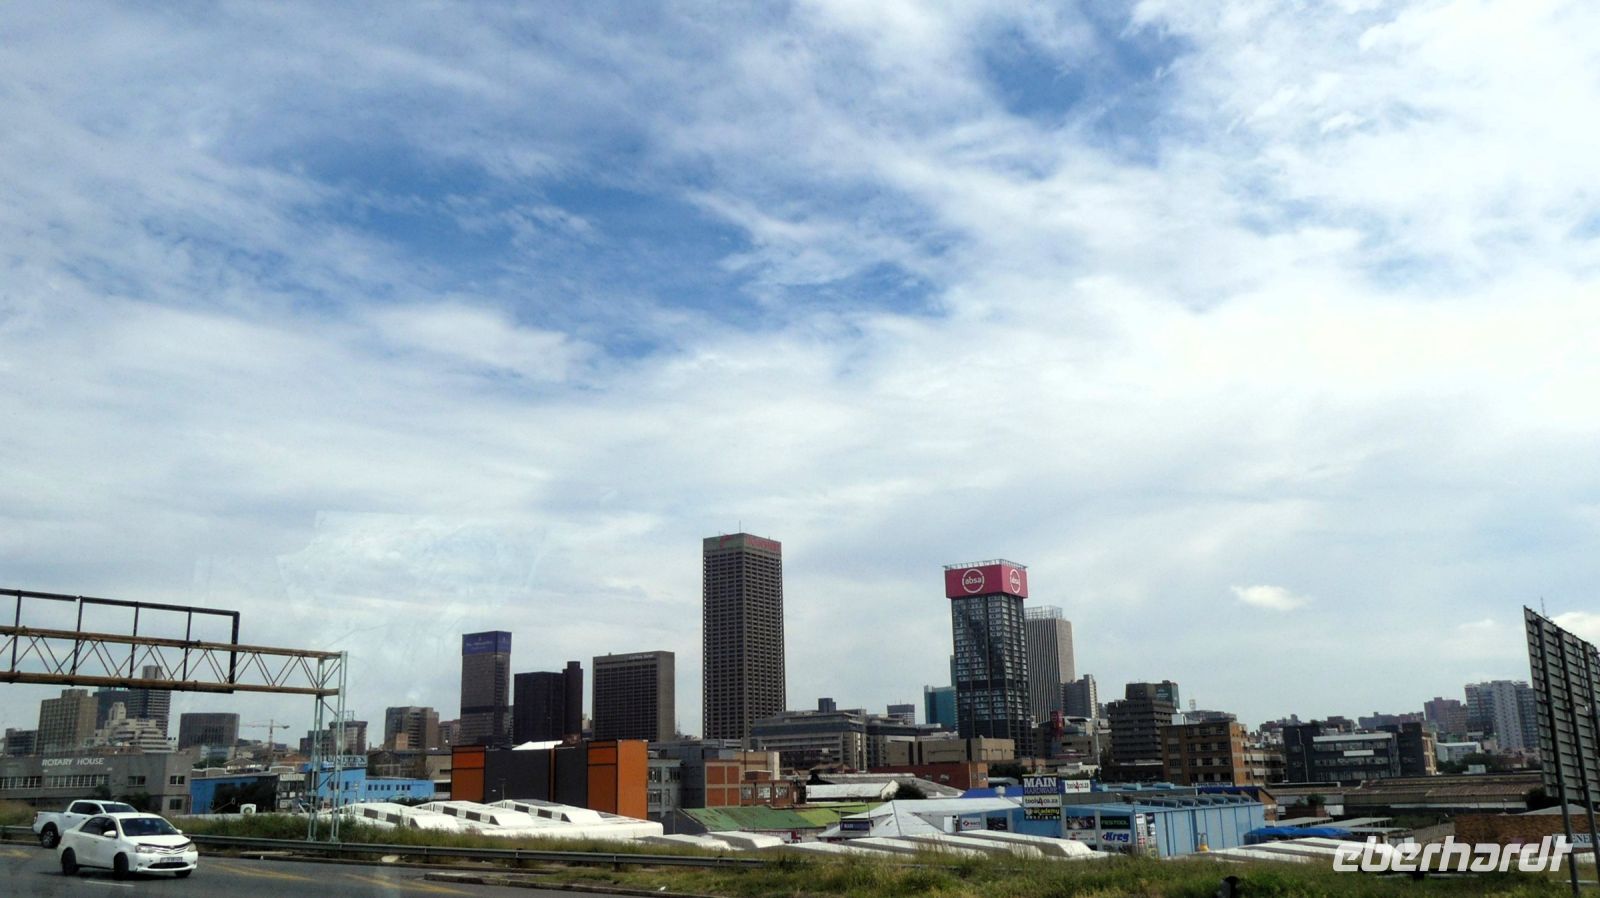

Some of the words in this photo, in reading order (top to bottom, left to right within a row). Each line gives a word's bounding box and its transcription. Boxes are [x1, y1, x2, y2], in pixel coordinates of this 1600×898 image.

[965, 576, 982, 585] absa
[77, 757, 104, 765] HOUSE
[1023, 777, 1057, 788] MAIN
[1106, 832, 1129, 842] Kreg
